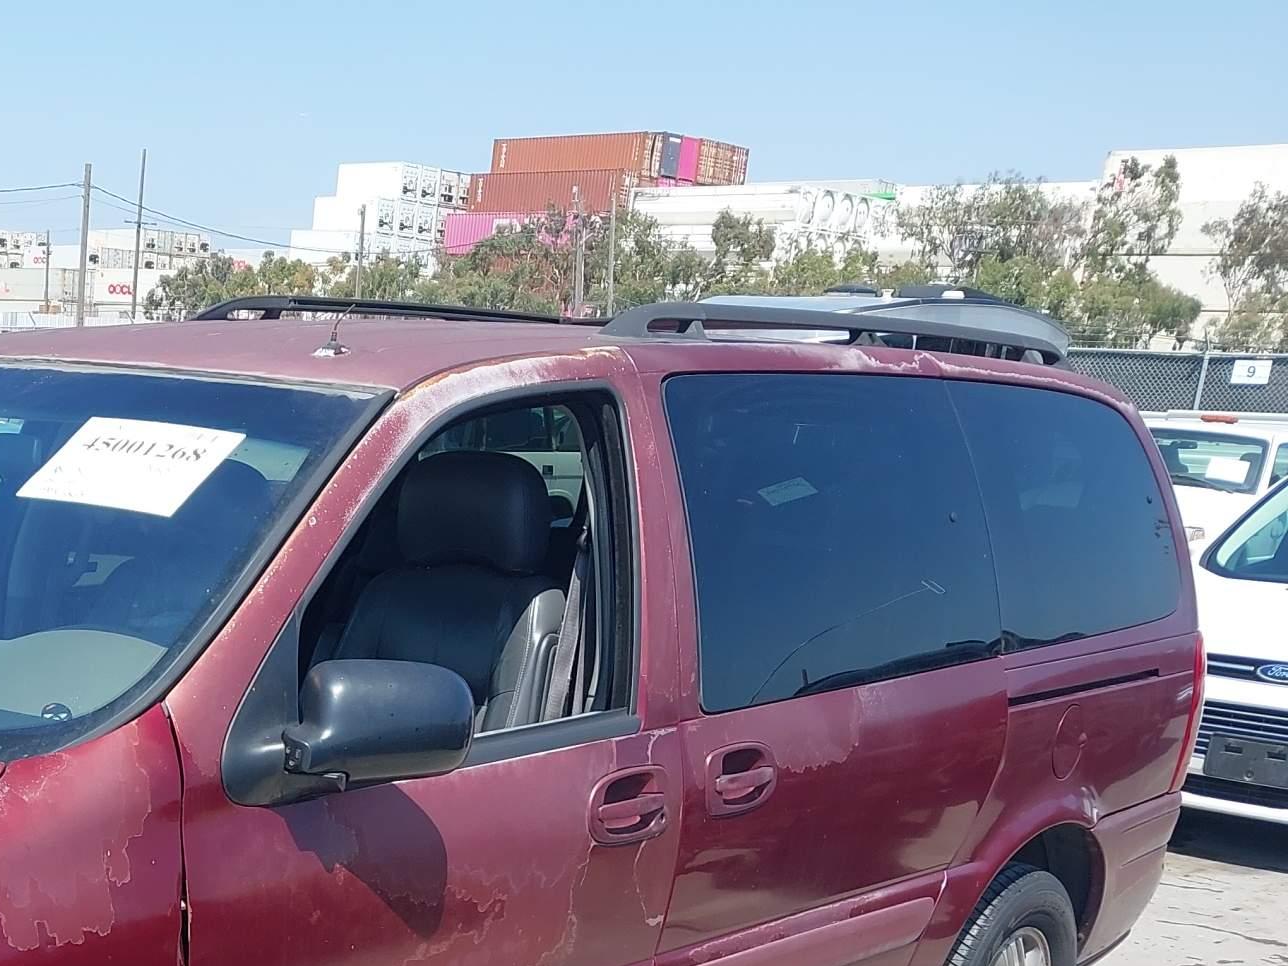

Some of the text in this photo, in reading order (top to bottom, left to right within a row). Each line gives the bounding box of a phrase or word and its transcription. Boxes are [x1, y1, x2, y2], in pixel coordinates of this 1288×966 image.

[107, 284, 133, 295] OOCL
[1246, 365, 1256, 378] 9
[83, 436, 207, 462] 45001268
